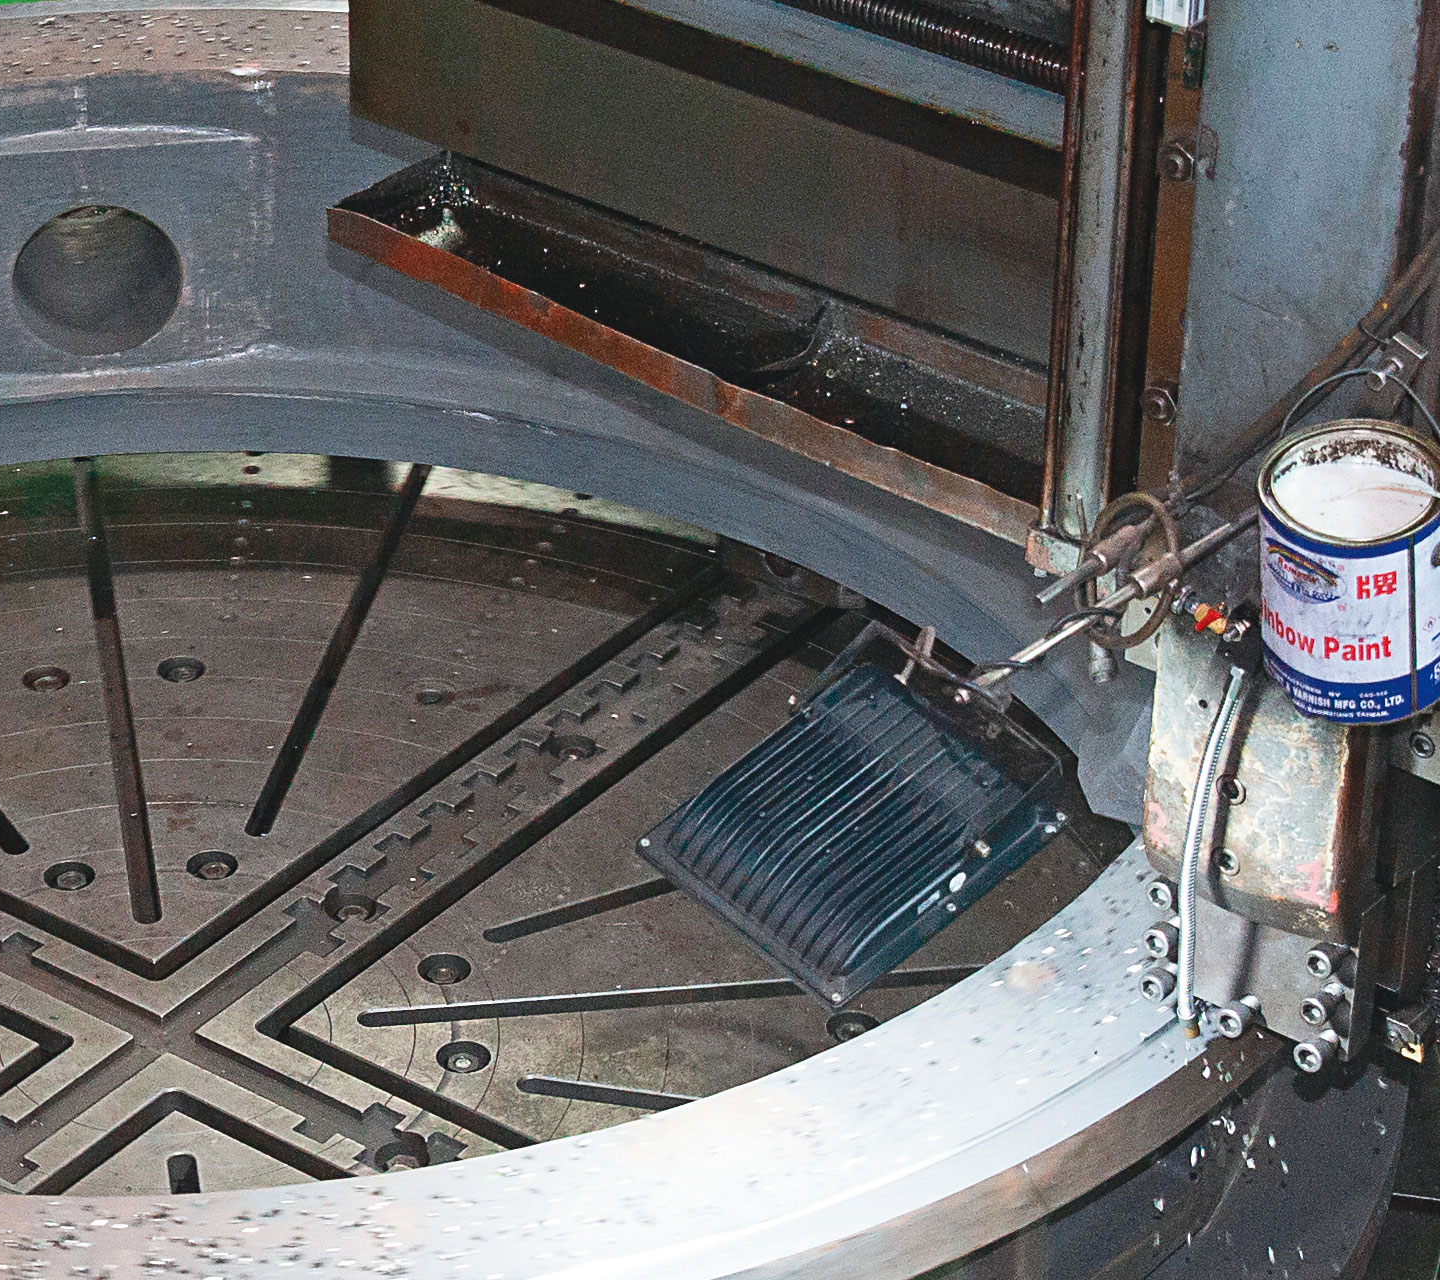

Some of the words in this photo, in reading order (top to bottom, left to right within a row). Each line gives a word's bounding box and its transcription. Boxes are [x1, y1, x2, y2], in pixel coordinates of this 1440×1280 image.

[1261, 598, 1315, 655] inbow
[1324, 635, 1392, 661] Paint
[1293, 687, 1331, 708] VARNISH
[1334, 699, 1356, 709] MFG
[1360, 700, 1381, 710] CO.,
[1385, 694, 1405, 707] LTD.
